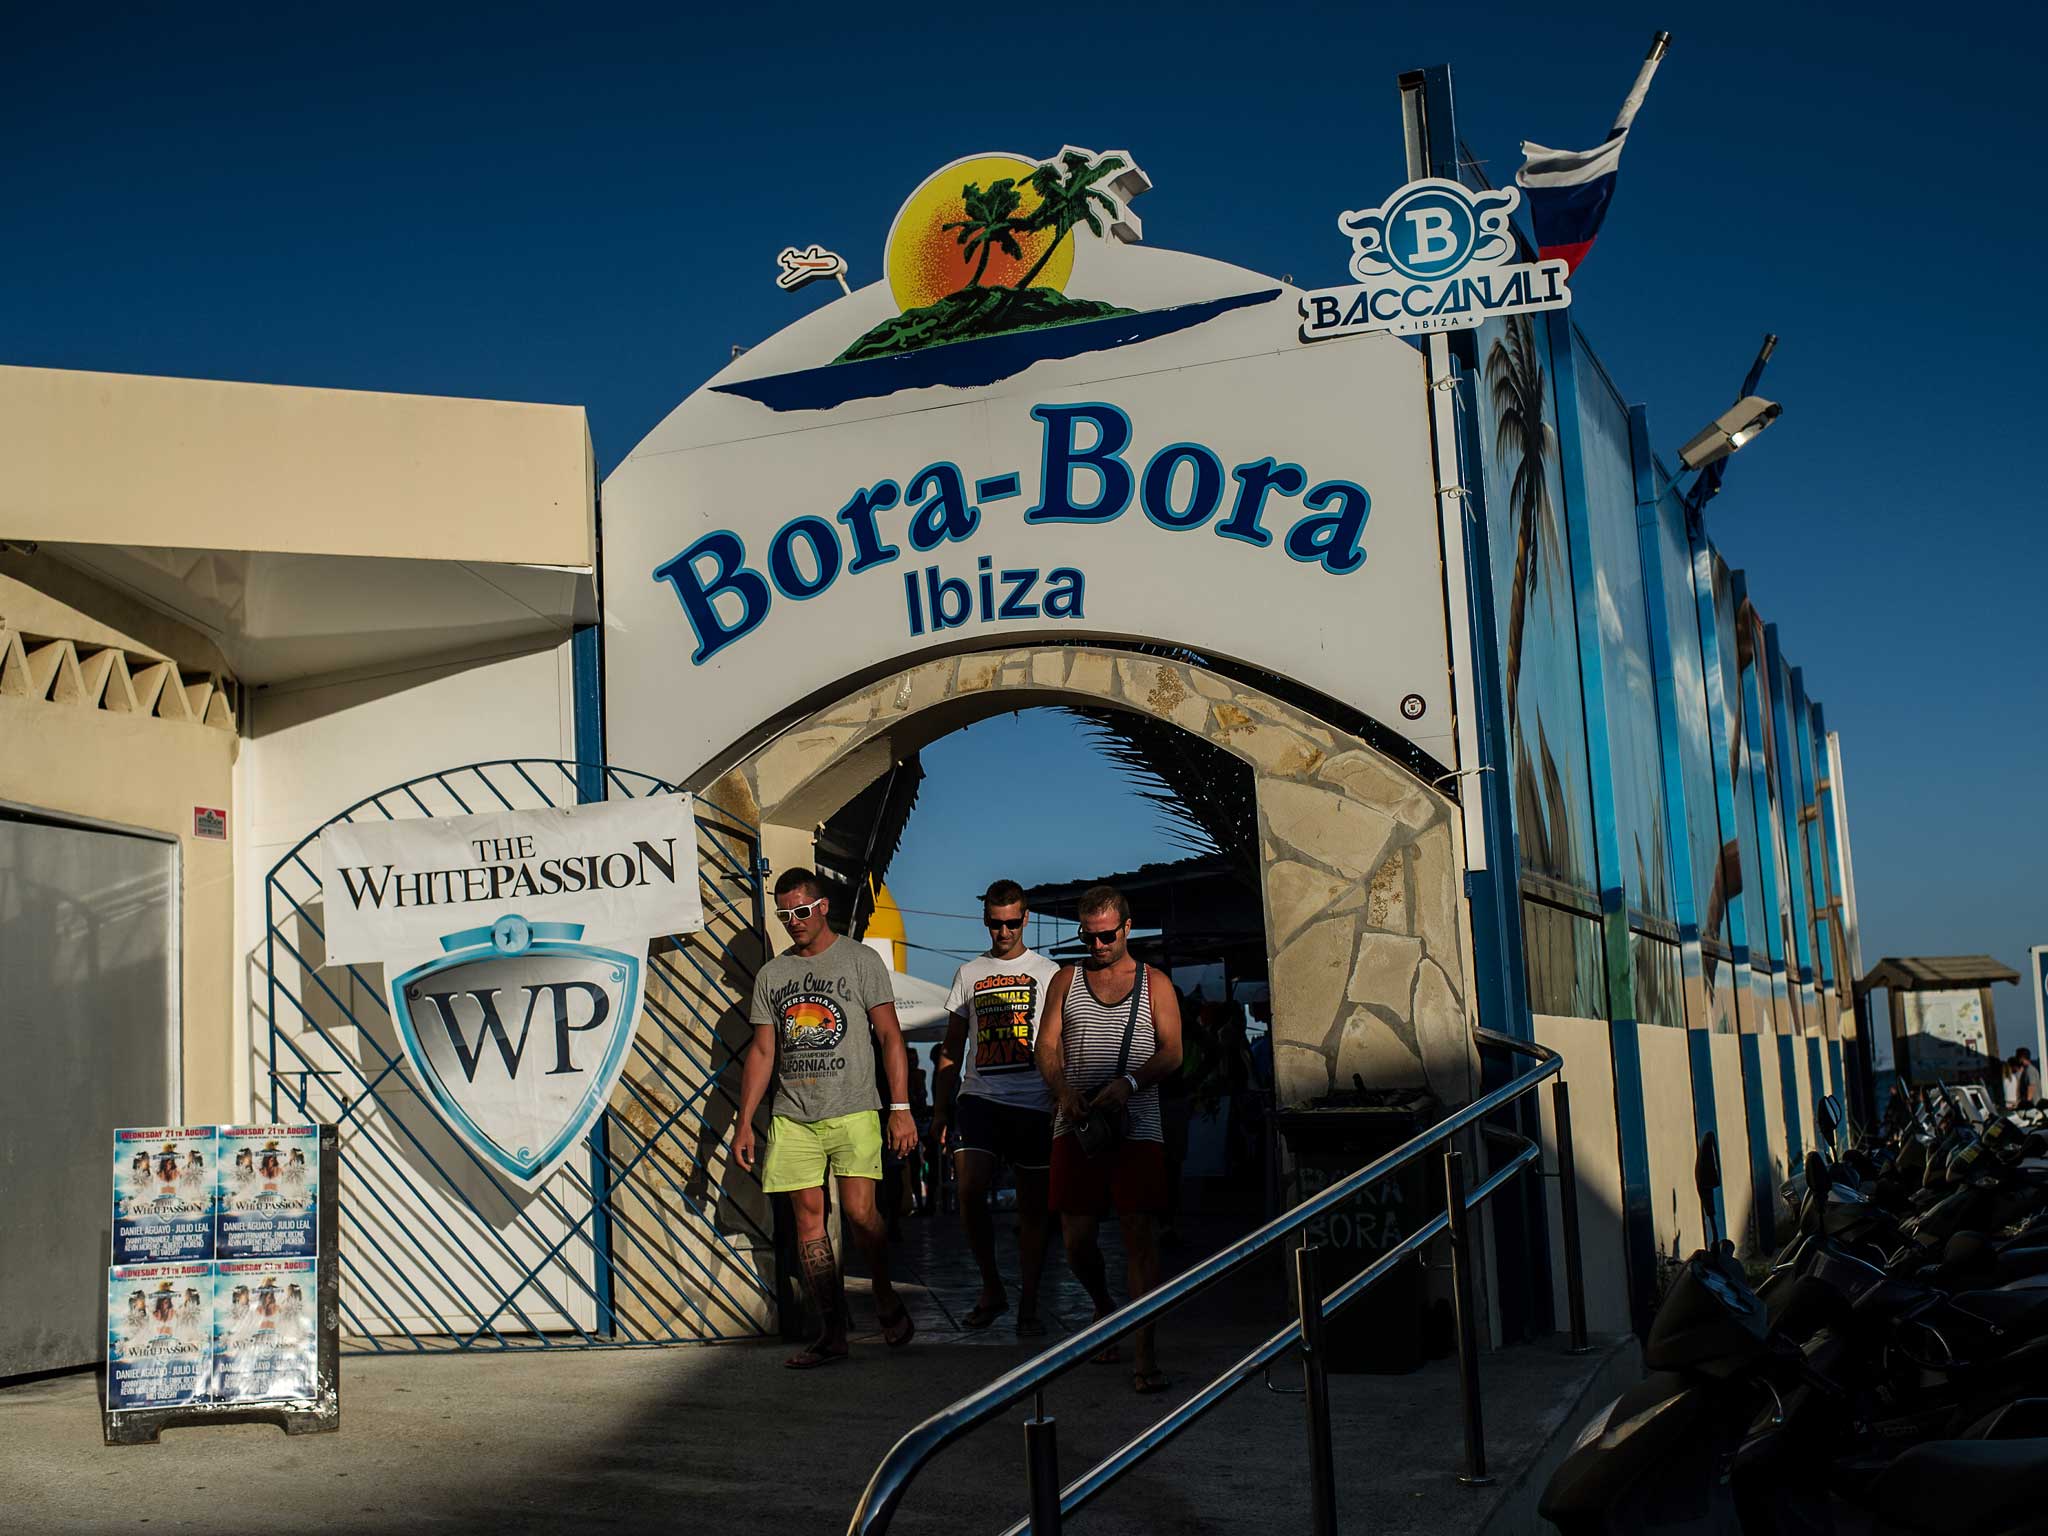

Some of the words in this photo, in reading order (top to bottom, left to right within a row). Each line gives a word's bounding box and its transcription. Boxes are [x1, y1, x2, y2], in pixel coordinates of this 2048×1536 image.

[1405, 207, 1458, 265] B
[1310, 266, 1564, 331] BACCANALI
[1414, 317, 1459, 330] IBIZA
[652, 402, 1372, 667] Bora-Bora
[903, 555, 1086, 637] Ibiza
[472, 835, 537, 863] THE
[803, 972, 833, 994] Cruz
[975, 976, 1015, 991] adidas
[975, 991, 1030, 1008] ORIGINALS
[977, 1004, 1029, 1016] ESTABLISHED
[809, 996, 843, 1046] CHAMPIONS
[425, 981, 610, 1084] WP
[977, 1029, 991, 1042] IN
[996, 1026, 1028, 1040] THE
[784, 1058, 846, 1074] ALIFORNIA.CO
[121, 1131, 162, 1139] WEDNESDAY
[185, 1129, 211, 1137] AUGUST
[223, 1128, 264, 1136] WEDNESDAY
[1298, 1167, 1404, 1205] BRA
[120, 1227, 143, 1236] DANIEL
[145, 1225, 170, 1234] AGUAYO
[175, 1224, 193, 1233] JULIO
[195, 1223, 209, 1232] LEAL
[224, 1222, 246, 1231] DANIEL
[247, 1221, 272, 1230] AGUAYO
[277, 1221, 295, 1230] JULIO
[296, 1220, 310, 1229] LEAL
[1309, 1210, 1403, 1250] BORA
[116, 1268, 158, 1277] WEDNESDAY
[161, 1267, 170, 1275] 21
[181, 1266, 208, 1274] AUGUST
[220, 1264, 261, 1272] WEDNESDAY
[284, 1262, 310, 1270] AUGUST
[116, 1369, 139, 1379] DANIEL
[140, 1367, 167, 1377] AGUAYO
[172, 1366, 190, 1375] JULIO
